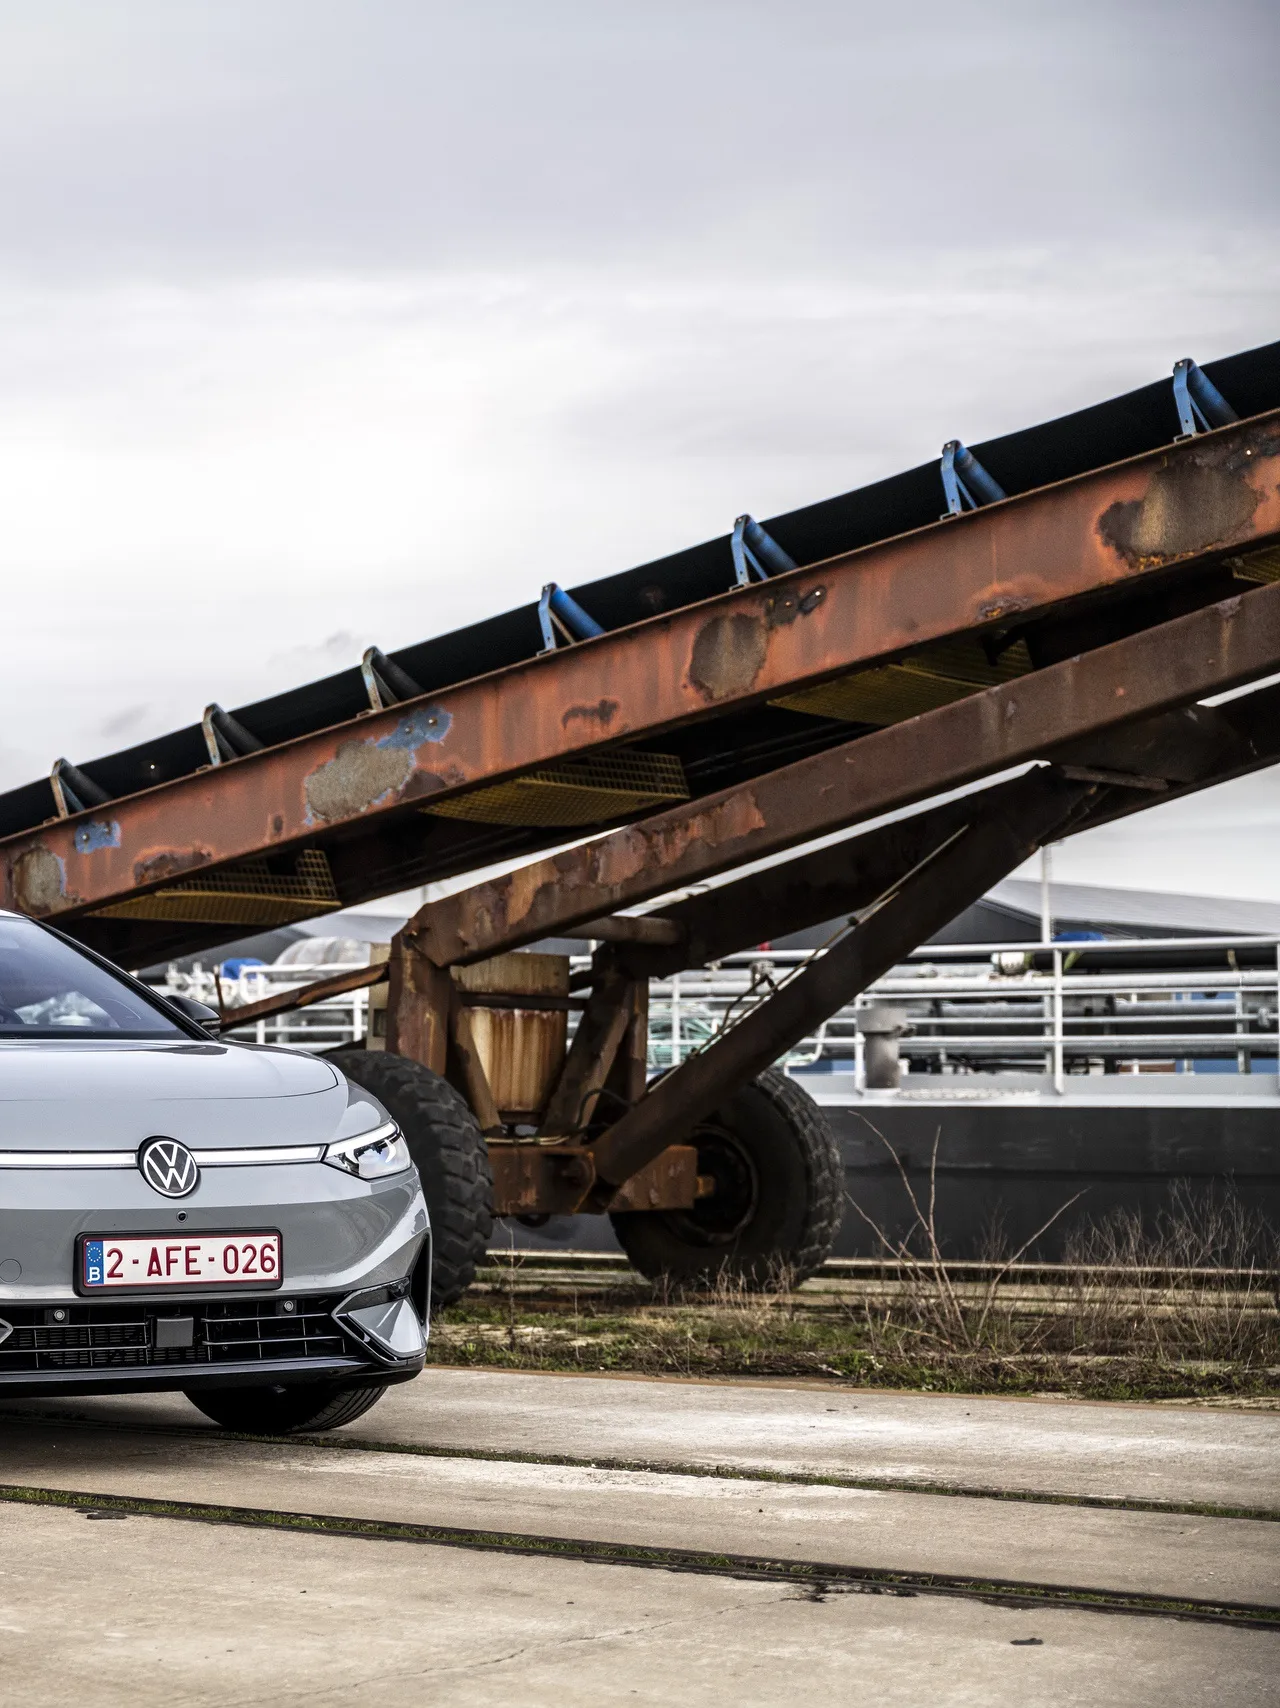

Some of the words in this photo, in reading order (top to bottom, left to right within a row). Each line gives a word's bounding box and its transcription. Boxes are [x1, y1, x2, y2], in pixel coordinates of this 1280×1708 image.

[143, 1140, 197, 1197] VW
[89, 1266, 101, 1281] B
[106, 1243, 276, 1279] 2-AFE-026
